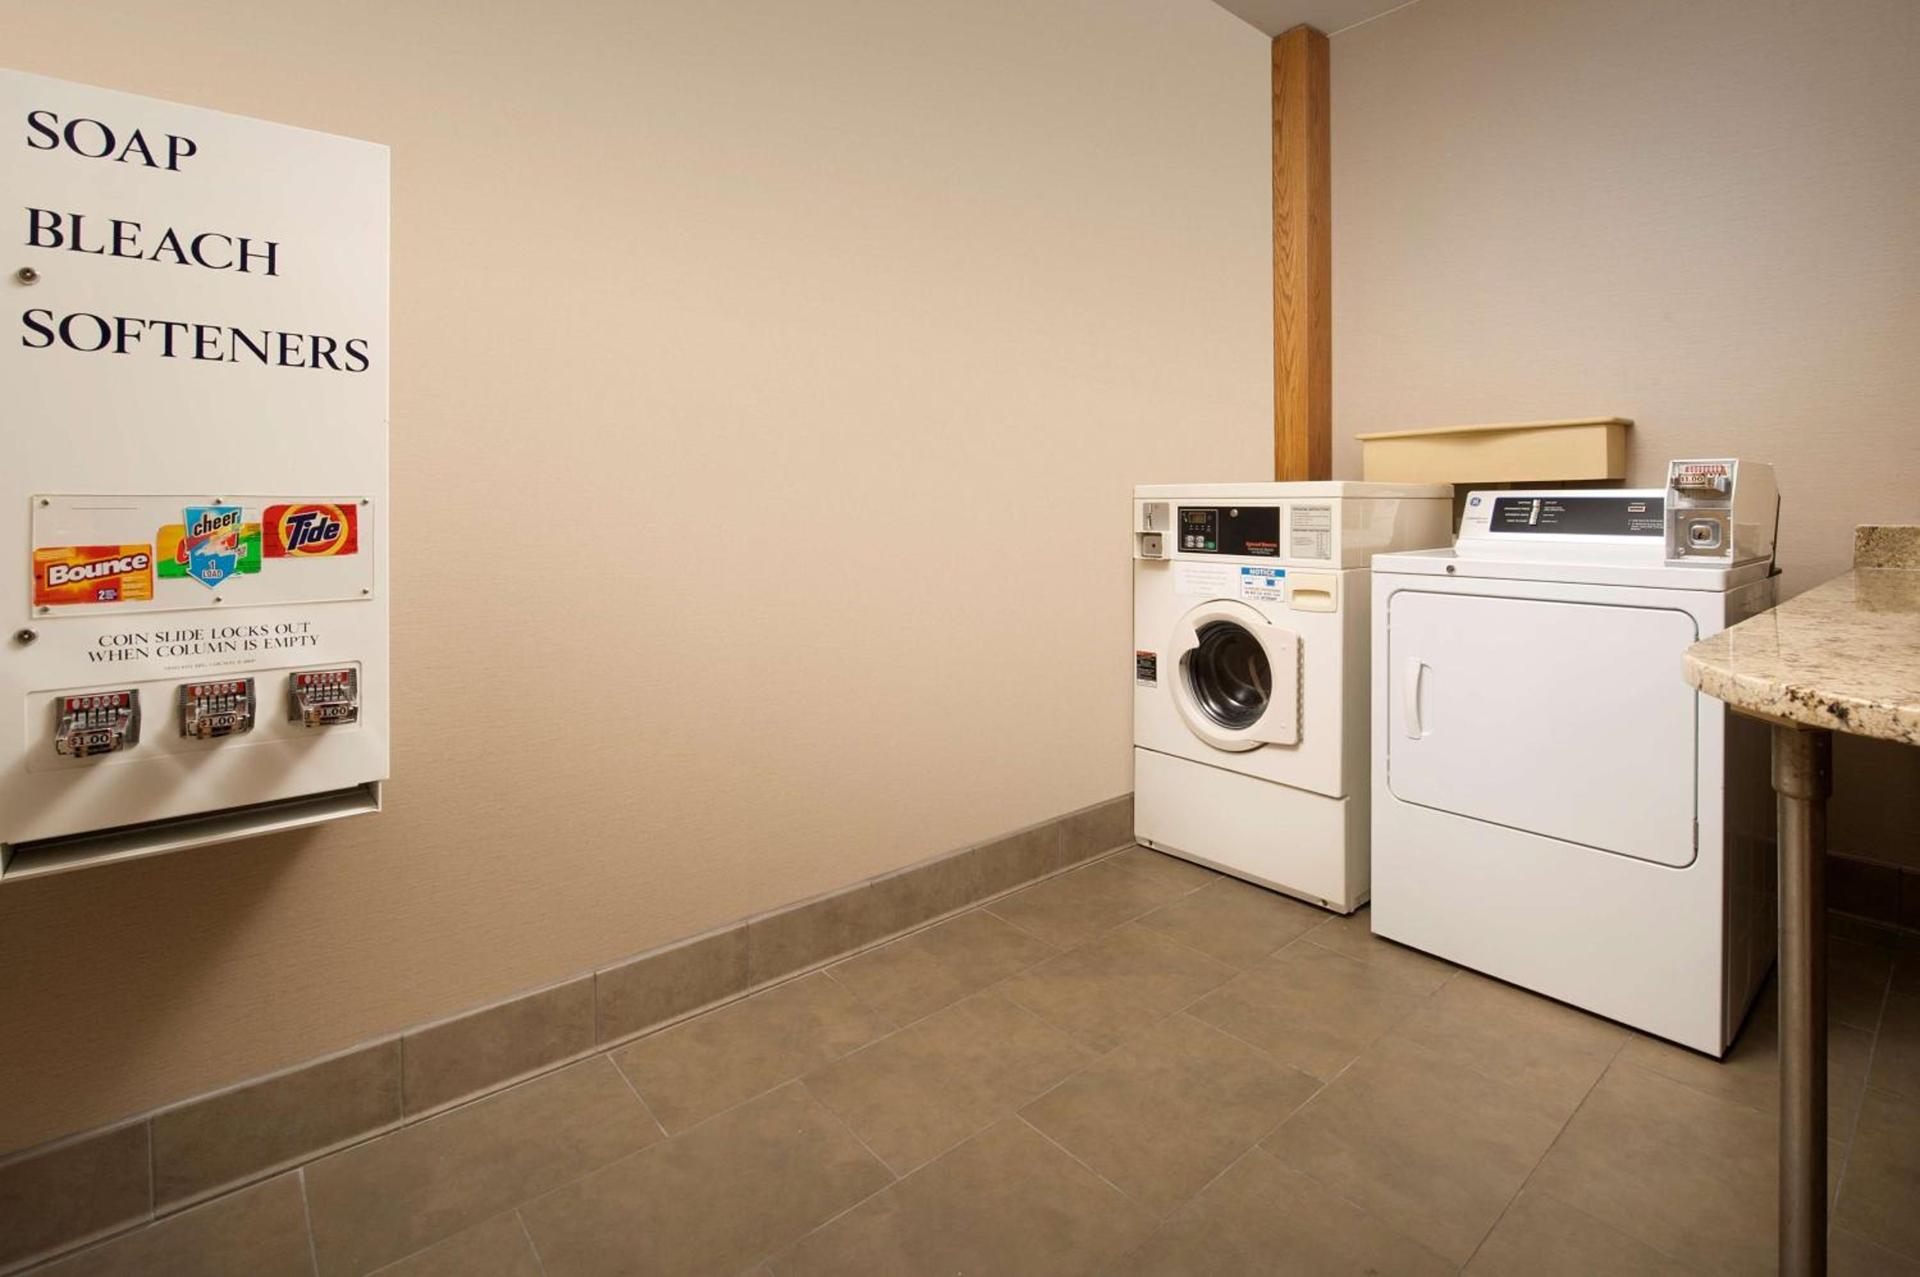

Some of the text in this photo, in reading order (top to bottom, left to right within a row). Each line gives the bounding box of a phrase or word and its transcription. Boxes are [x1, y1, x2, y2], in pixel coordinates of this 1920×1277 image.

[27, 110, 197, 172] SOAP
[25, 207, 280, 276] BLEACH
[22, 308, 370, 373] SOFTENERS
[193, 511, 239, 536] cheer
[286, 512, 340, 550] Tide
[49, 554, 148, 585] Bounce
[98, 590, 105, 600] 2
[99, 622, 311, 647] COIN SLIDE LOCKS OUT
[88, 635, 320, 663] WHEN COLUMN IS EMPTY
[201, 716, 235, 727] $1.00
[316, 707, 347, 718] $1.00
[68, 734, 108, 746] $1.00
